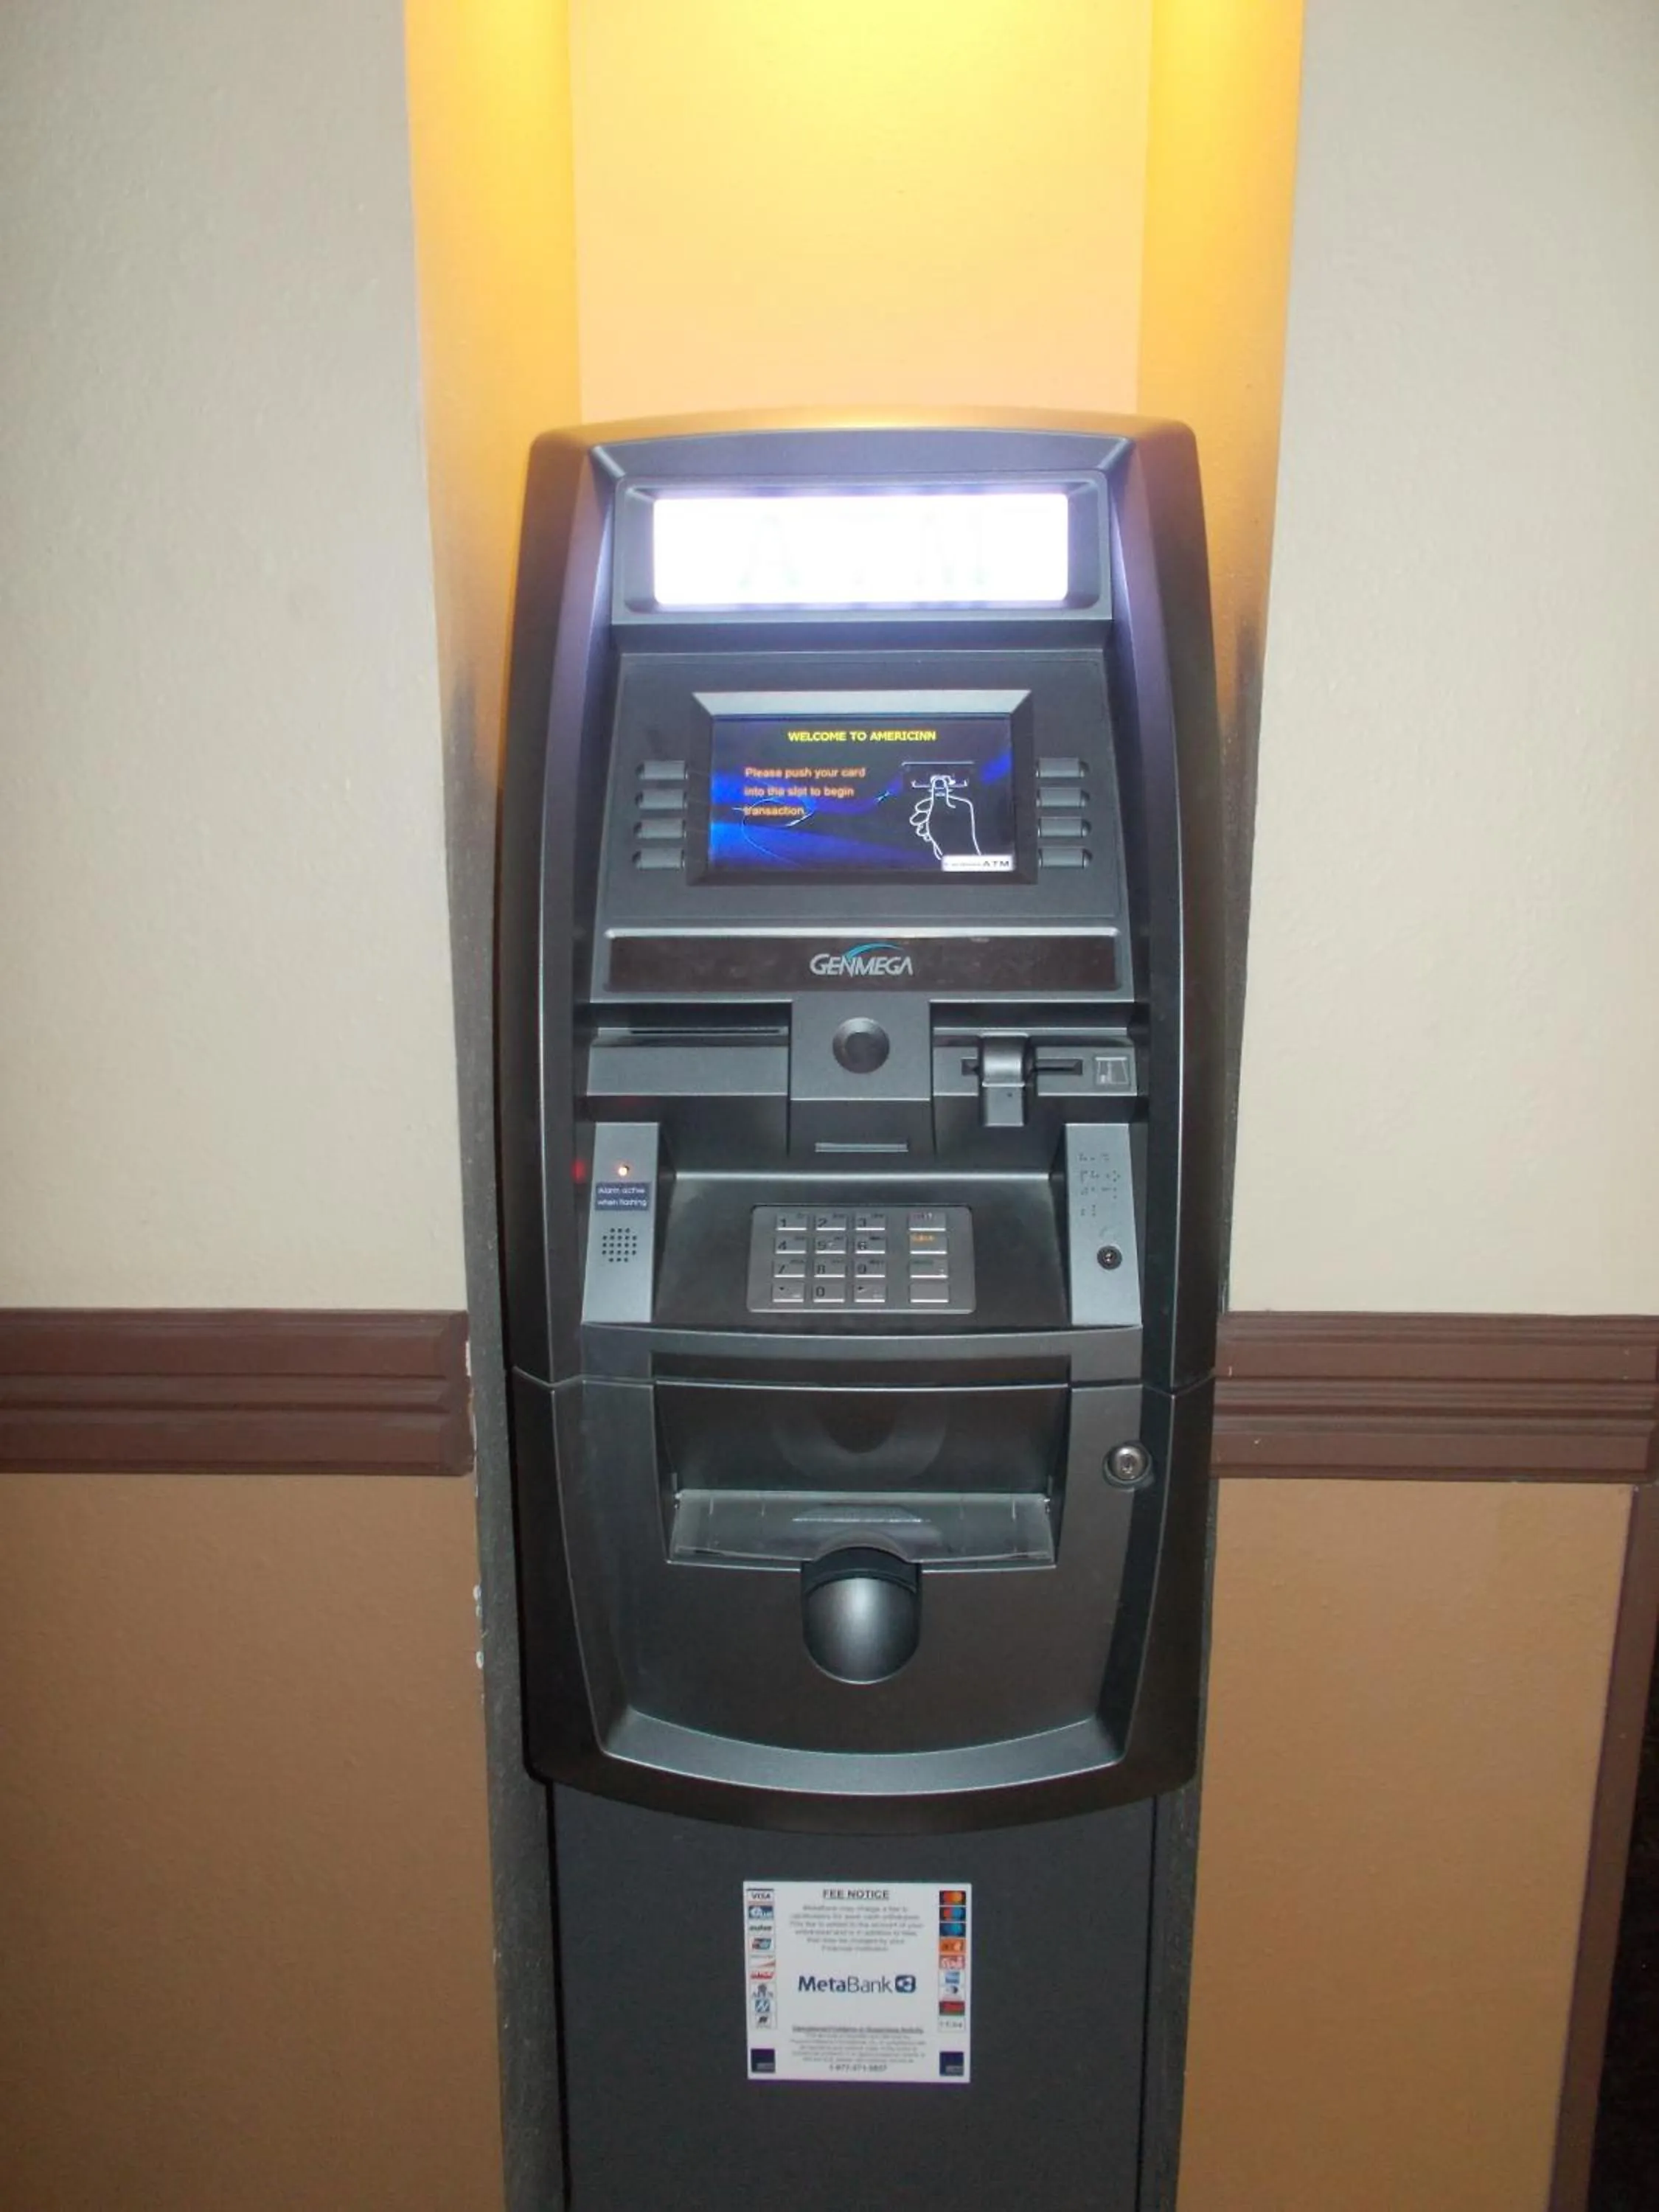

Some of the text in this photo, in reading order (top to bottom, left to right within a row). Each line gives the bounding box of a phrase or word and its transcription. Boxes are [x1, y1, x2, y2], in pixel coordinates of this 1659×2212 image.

[787, 731, 936, 741] WELCOME TO AMERICINN
[745, 767, 866, 779] Please push your card
[744, 786, 855, 799] into the slot to begin
[744, 806, 804, 816] transaction
[810, 953, 914, 978] GENMEGA
[780, 1218, 787, 1227] 1
[818, 1218, 827, 1227] 2
[778, 1240, 787, 1250] 4
[858, 1241, 867, 1250] 6
[815, 1286, 825, 1297] 0
[822, 1889, 890, 1899] FEE NOTICE
[798, 1975, 893, 1993] MetaBank
